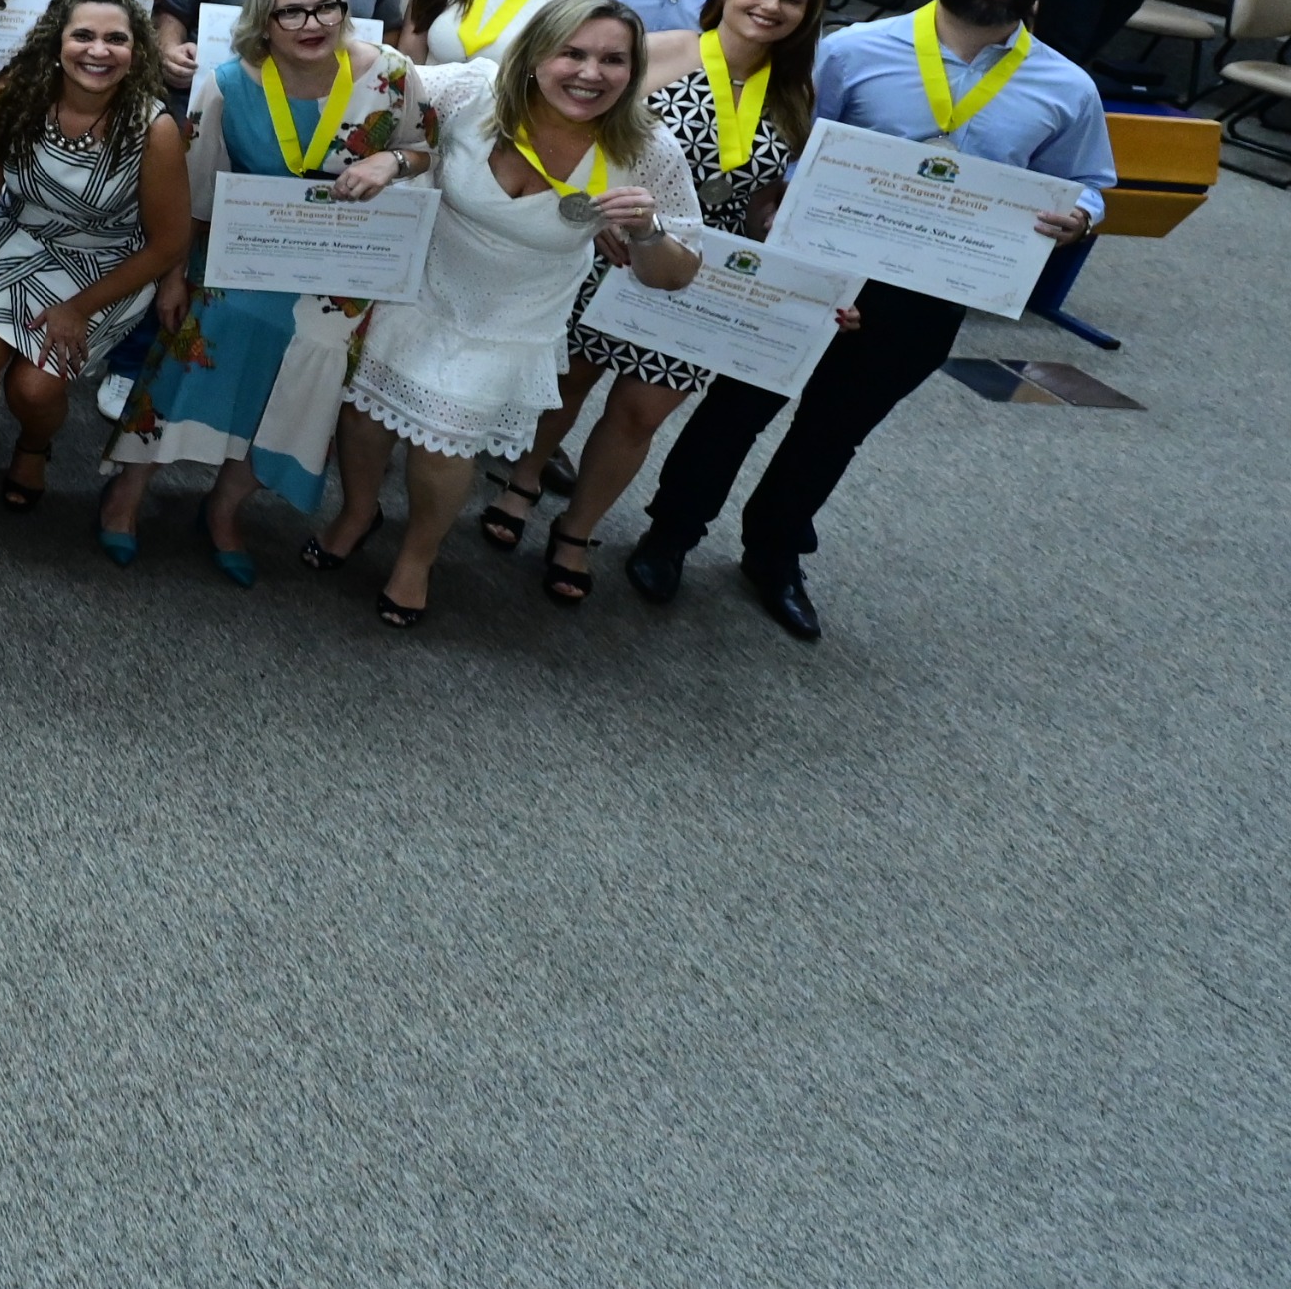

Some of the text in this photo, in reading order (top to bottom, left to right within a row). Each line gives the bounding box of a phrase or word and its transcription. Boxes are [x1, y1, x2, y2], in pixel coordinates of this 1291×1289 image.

[868, 177, 988, 212] Félix Augusto Perillo
[837, 205, 873, 220] Ademar
[876, 215, 913, 230] Pereira
[931, 228, 956, 241] Silva
[959, 235, 995, 250] Júnior
